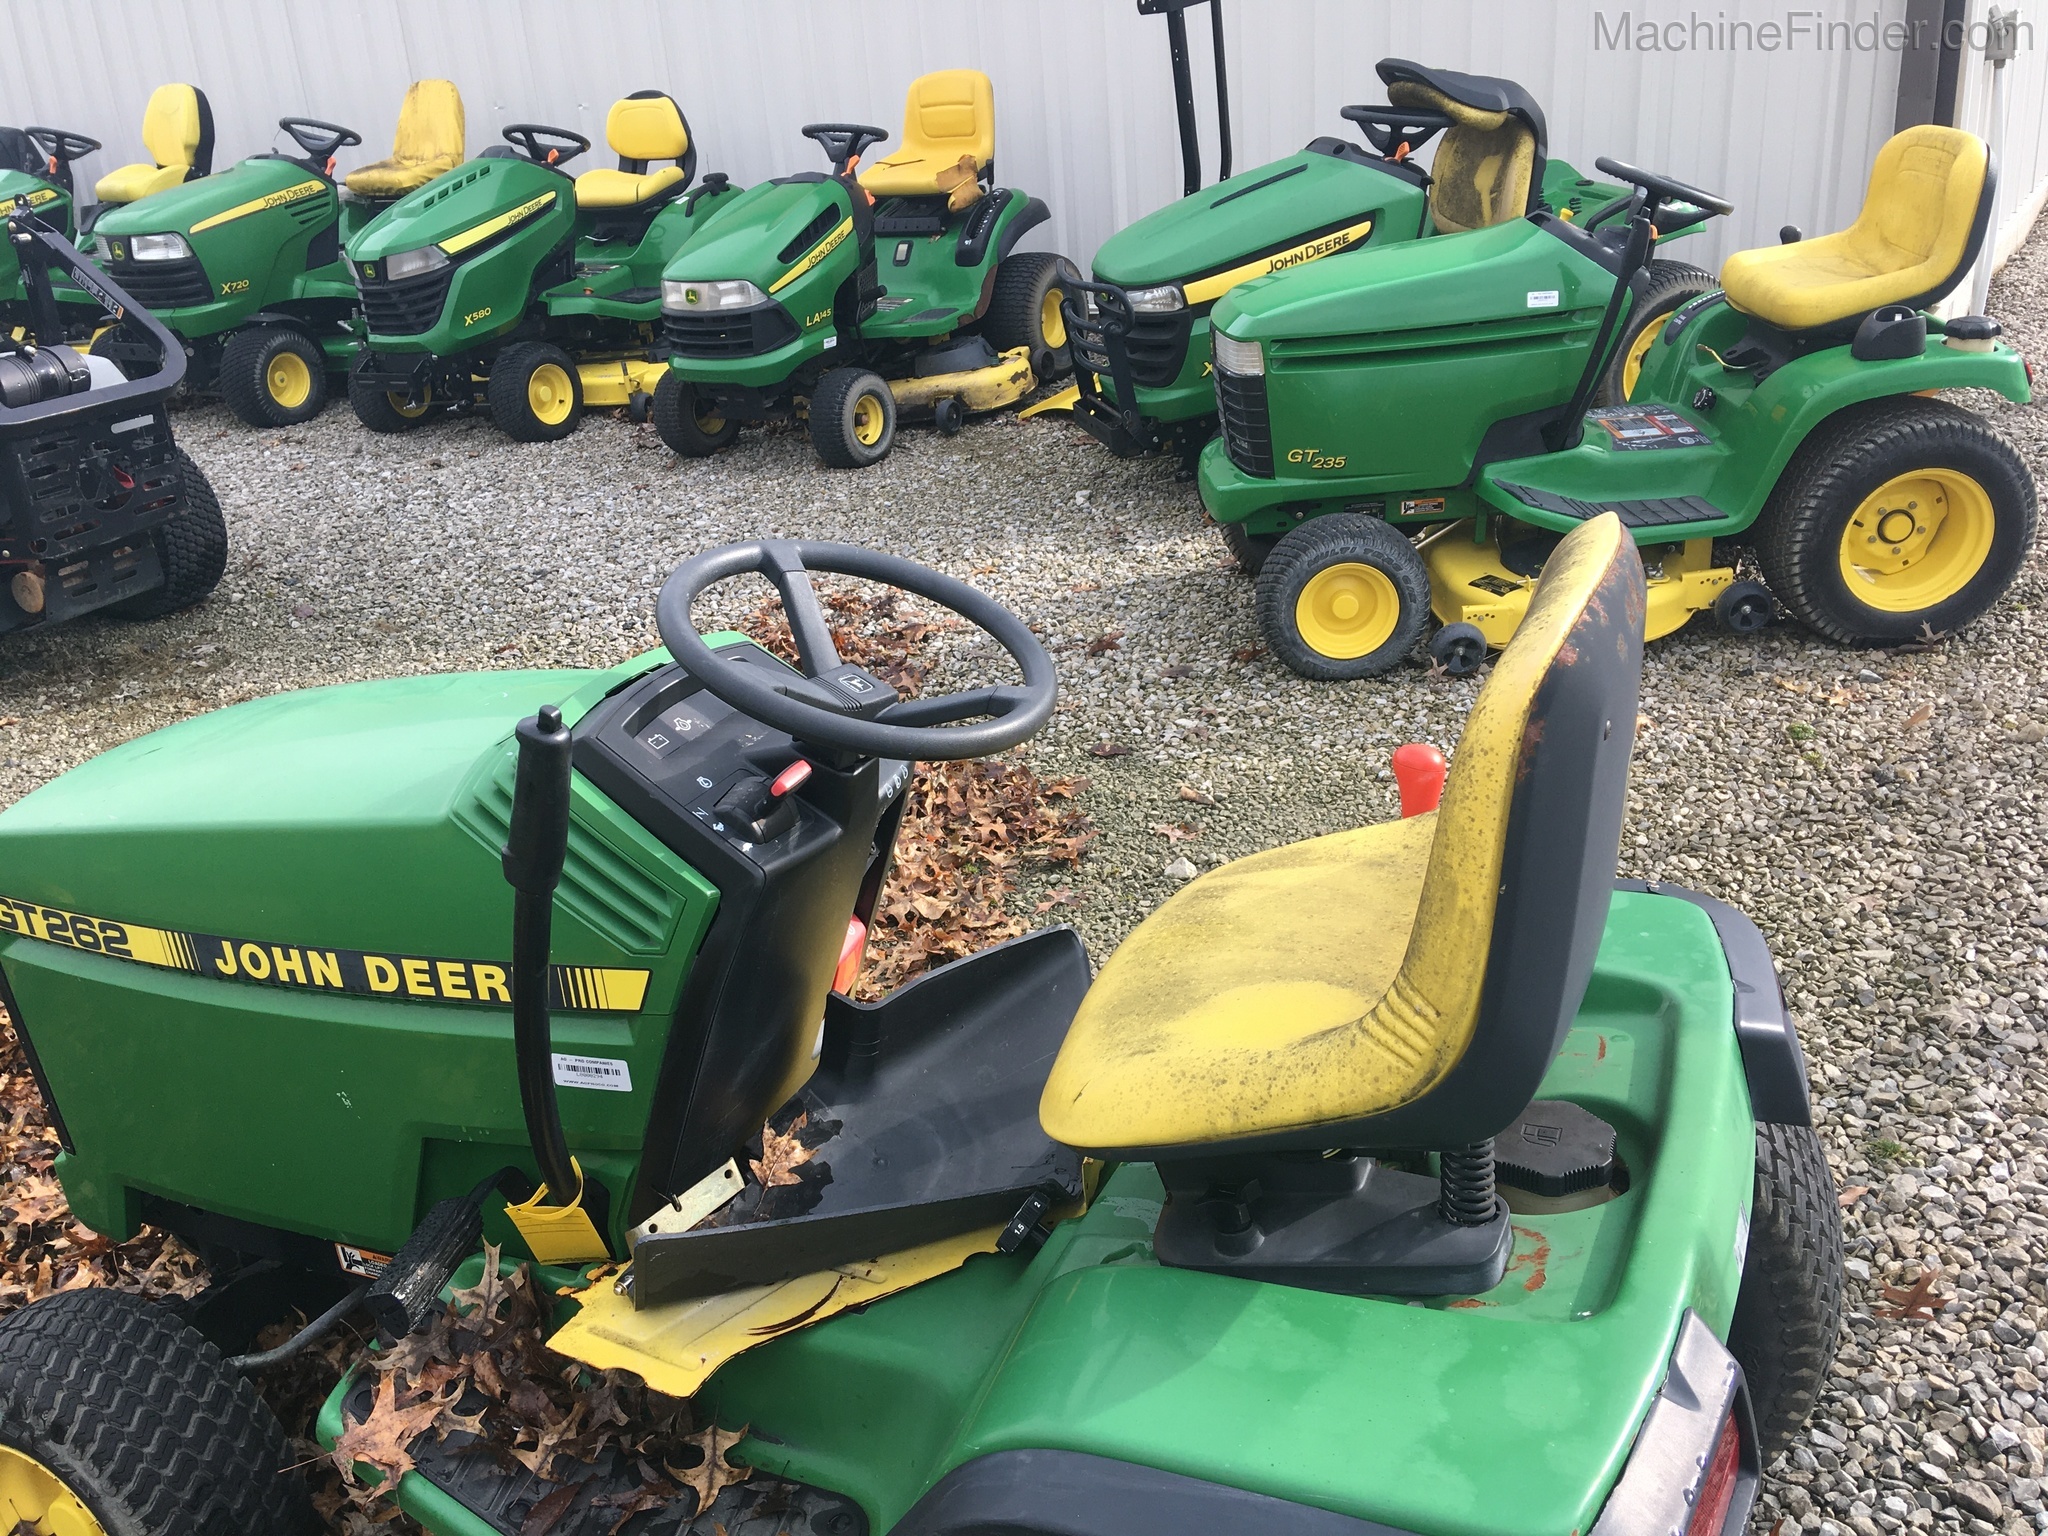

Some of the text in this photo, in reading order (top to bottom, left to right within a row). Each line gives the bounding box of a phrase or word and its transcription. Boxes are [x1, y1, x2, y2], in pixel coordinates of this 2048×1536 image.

[263, 184, 316, 208] JOHN DEERE
[508, 199, 543, 226] JOHN DEERE
[807, 230, 846, 269] JOHN DEERE
[1266, 232, 1351, 275] JOHN DEERE
[220, 279, 250, 295] X720
[464, 306, 492, 327] X580
[806, 307, 832, 327] LA145
[1287, 449, 1347, 469] GT235
[0, 897, 134, 958] GT262
[214, 940, 513, 1003] JOHN DEER
[1014, 1223, 1025, 1235] 1.5
